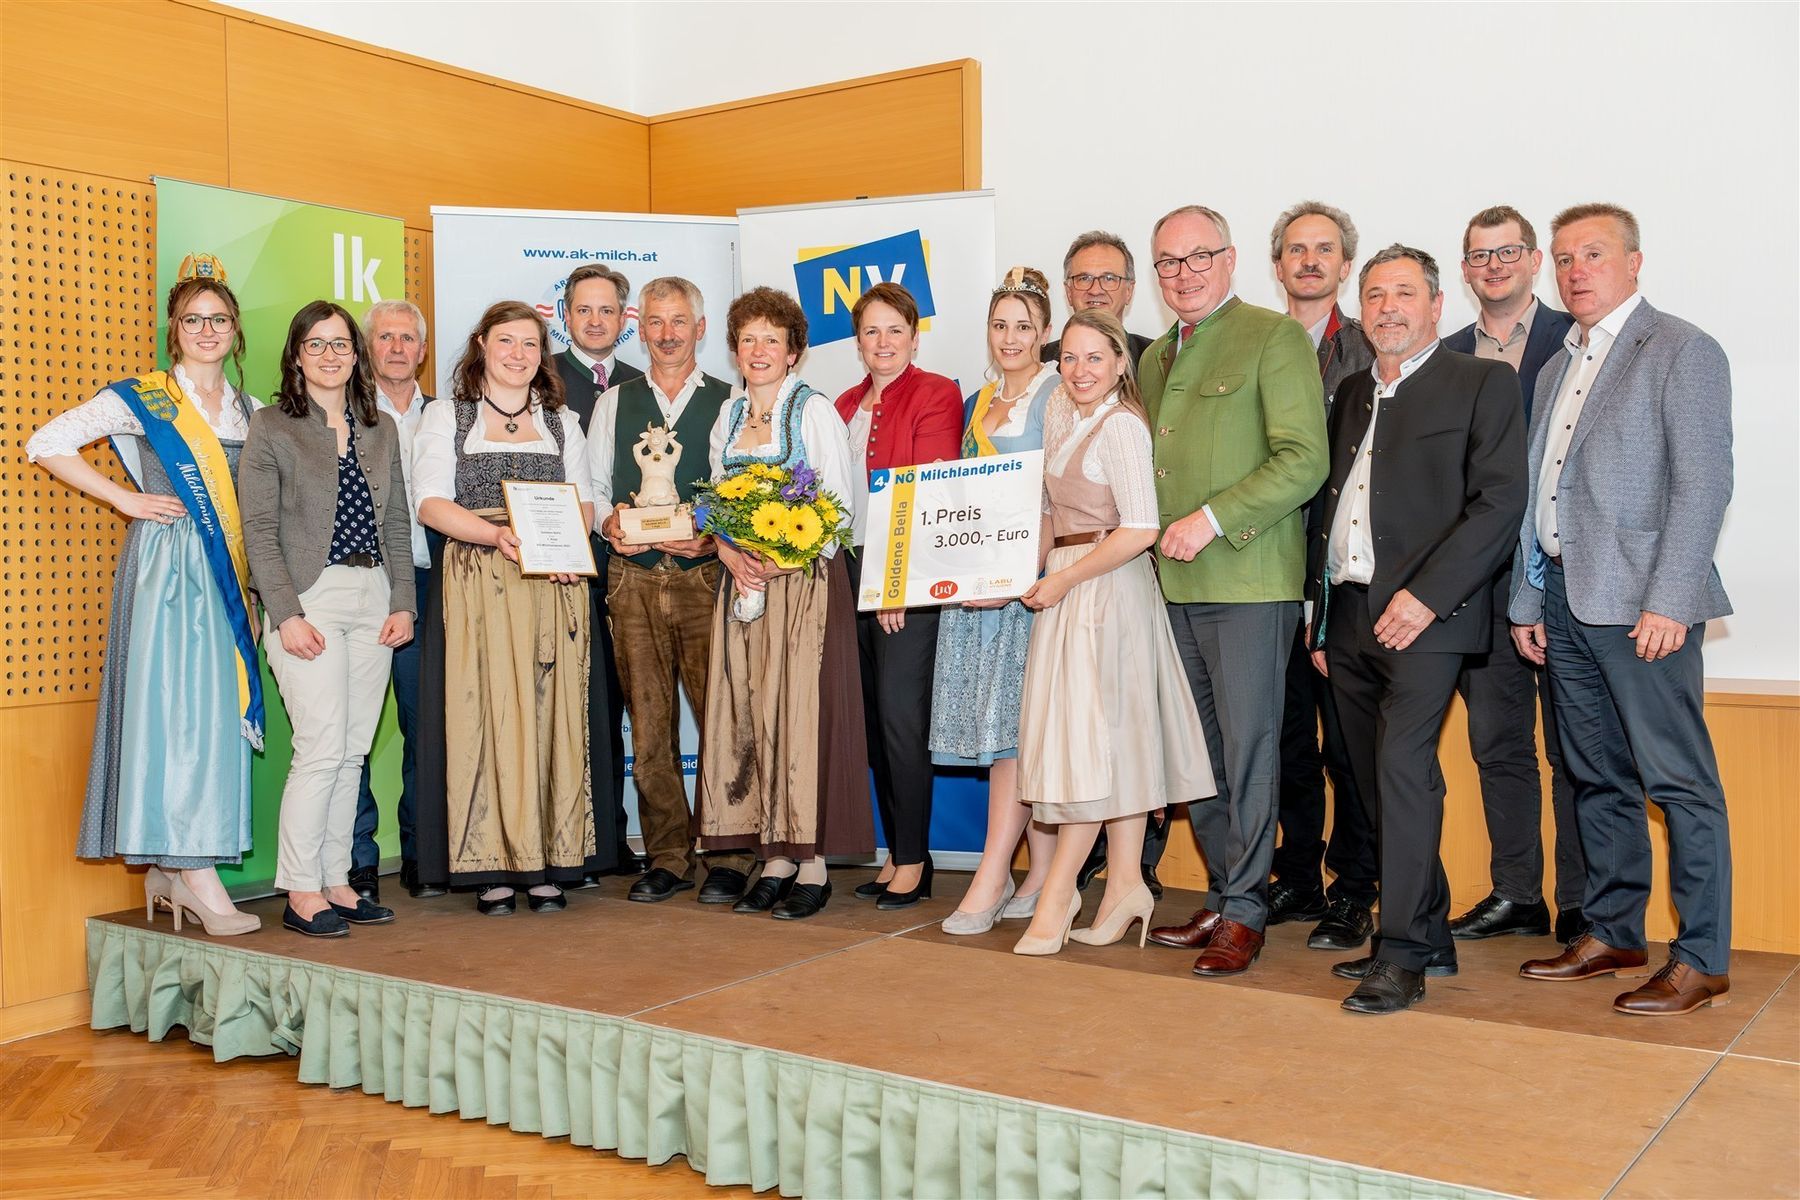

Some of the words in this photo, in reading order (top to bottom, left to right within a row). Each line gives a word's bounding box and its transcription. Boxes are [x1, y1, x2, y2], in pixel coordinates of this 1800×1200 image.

[523, 248, 658, 262] www.ak-milch.at
[895, 469, 916, 485] NÖ
[920, 459, 1023, 482] Milchlandpreis
[176, 461, 215, 537] Milchkönigin
[894, 501, 908, 537] Bella
[920, 511, 932, 526] 1.
[936, 505, 982, 525] Preis
[997, 528, 1029, 542] Euro
[888, 541, 904, 599] Goldene
